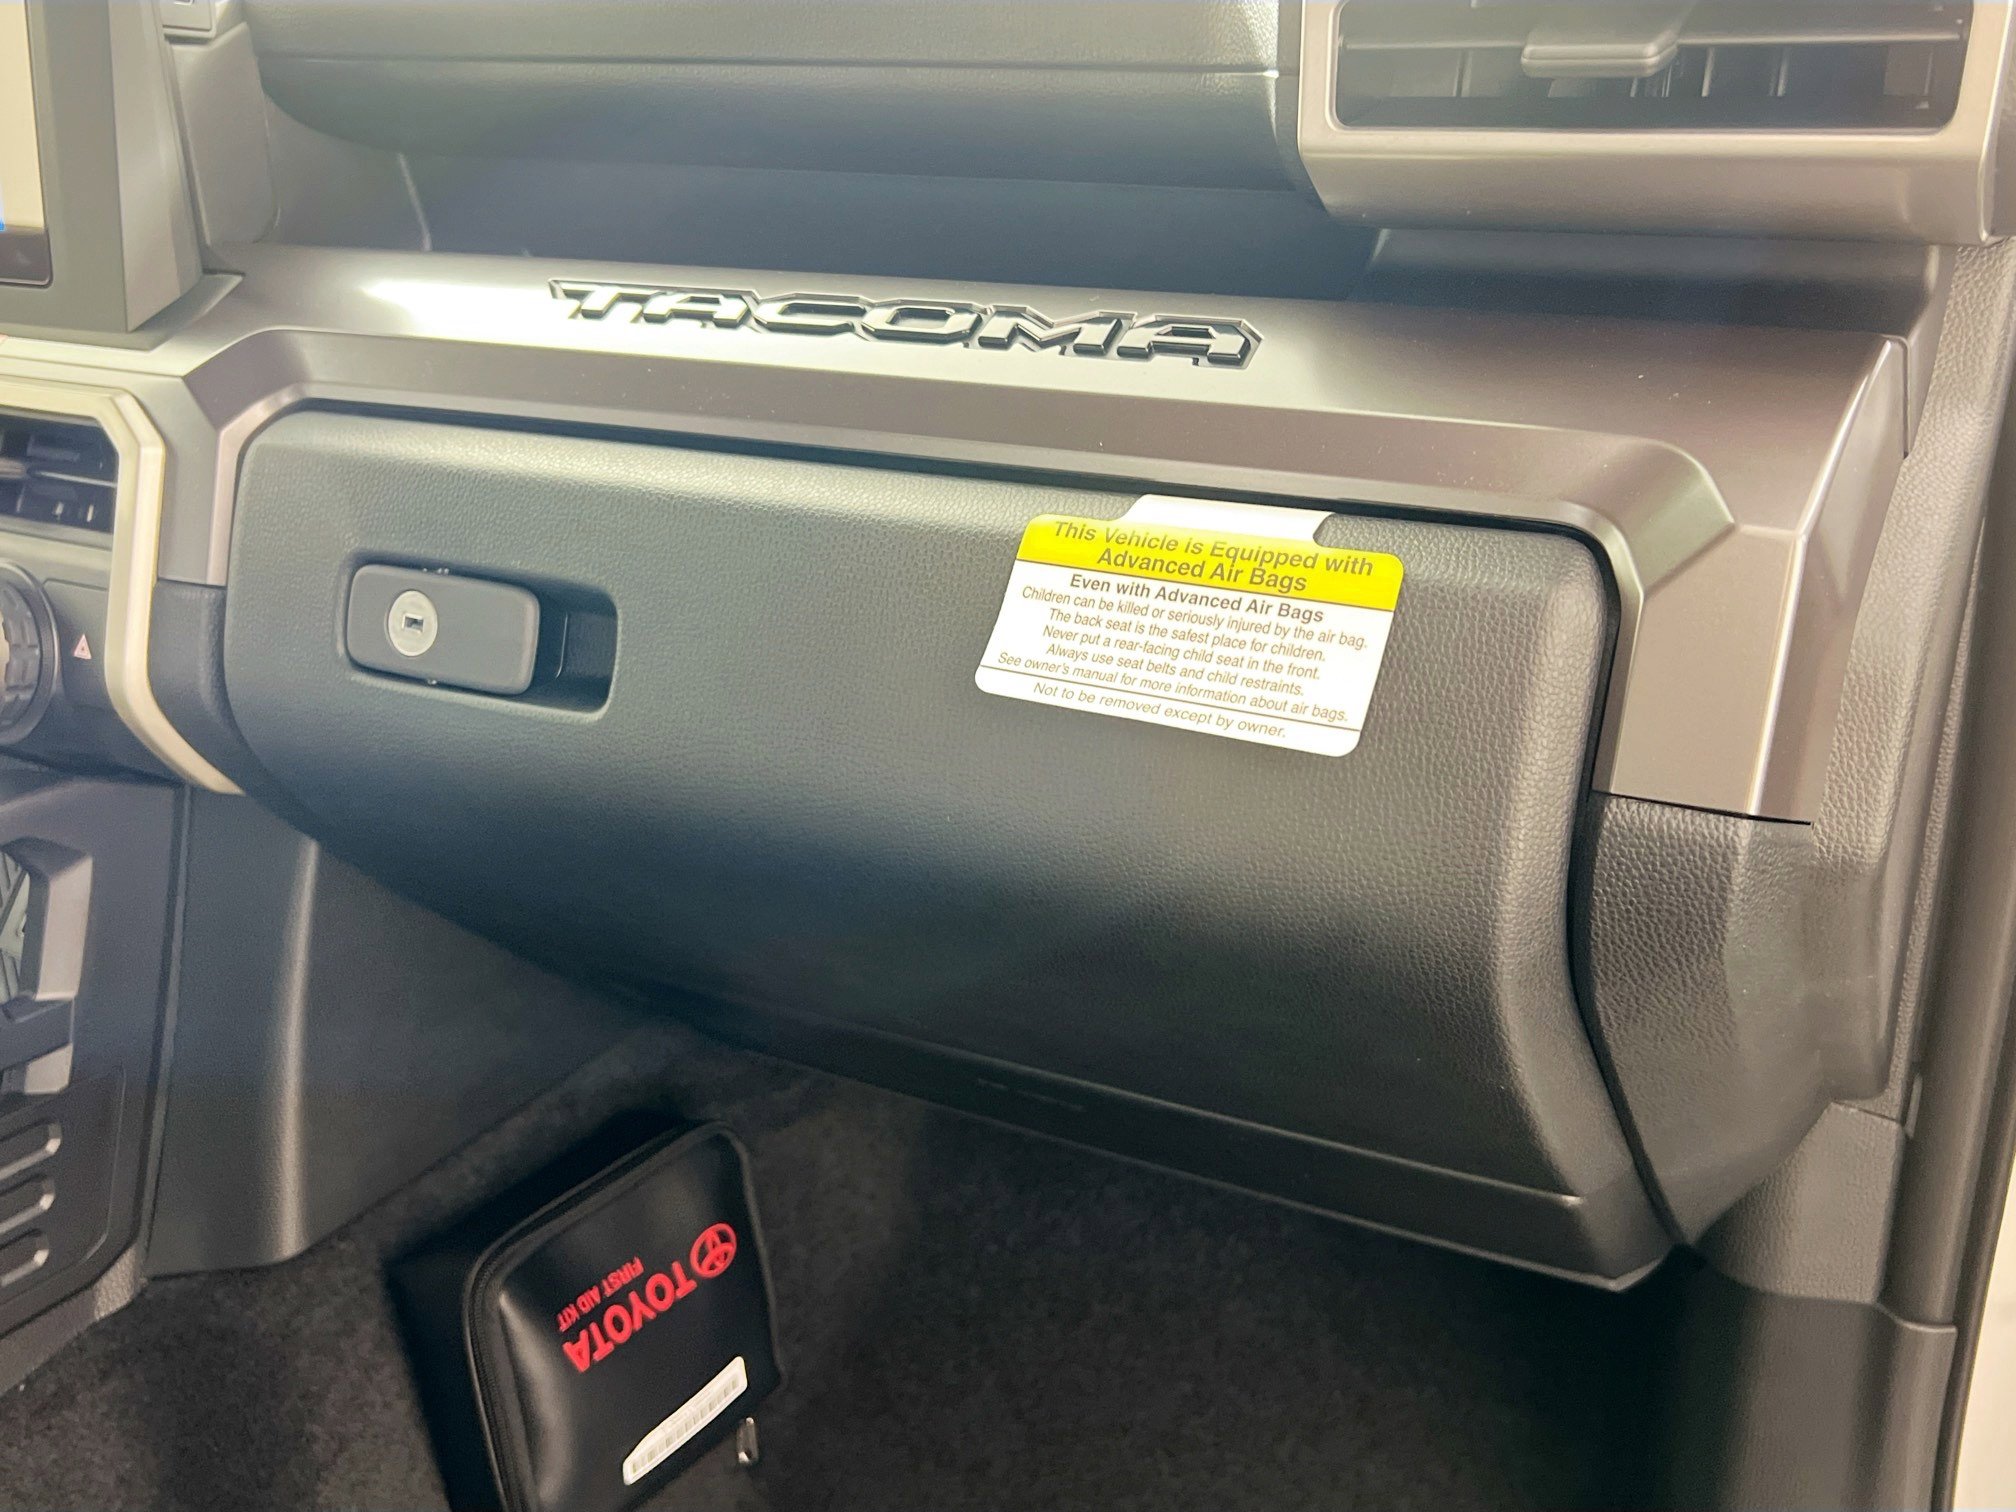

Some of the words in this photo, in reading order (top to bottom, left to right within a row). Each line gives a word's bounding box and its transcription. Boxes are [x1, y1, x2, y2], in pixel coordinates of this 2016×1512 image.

[550, 278, 1263, 369] TACOMA
[1054, 520, 1097, 542] This
[1104, 526, 1179, 552] Vehicle
[1183, 536, 1204, 555] is
[1208, 540, 1320, 570] Equipped
[1324, 556, 1374, 577] with
[1095, 546, 1207, 579] Advanced
[1207, 561, 1244, 583] Air
[1247, 566, 1308, 595] Bags
[1021, 584, 1071, 605] Children
[1072, 595, 1094, 609] can
[1096, 595, 1115, 612] be
[1115, 598, 1150, 617] killed
[1150, 606, 1166, 619] or
[1166, 608, 1225, 631] seriously
[1225, 614, 1272, 635] injured
[1272, 621, 1291, 640] by
[1292, 624, 1315, 641] the
[1316, 628, 1337, 644] air
[1337, 630, 1367, 651] bag.
[1069, 572, 1111, 593] Even
[1115, 580, 1151, 599] with
[1153, 584, 1243, 611] Advanced
[1244, 597, 1274, 615] Air
[1276, 601, 1324, 625] Bags
[1041, 623, 1079, 642] Never
[1078, 632, 1101, 646] put
[1101, 636, 1112, 648] a
[1112, 637, 1181, 660] rear-facing
[1181, 646, 1215, 664] child
[1214, 653, 1245, 669] seat
[1245, 658, 1260, 671] in
[1261, 658, 1284, 674] the
[1285, 661, 1320, 680] front.
[1048, 606, 1072, 623] The
[1072, 610, 1104, 628] back
[1103, 618, 1133, 633] seat
[1133, 619, 1146, 635] is
[1147, 622, 1169, 638] the
[1169, 627, 1210, 645] safest
[1209, 632, 1247, 650] place
[1248, 636, 1269, 653] for
[1269, 640, 1326, 662] children.
[996, 650, 1022, 667] See
[1022, 657, 1070, 675] owner's
[1070, 666, 1119, 683] manual
[1118, 671, 1139, 686] for
[1138, 677, 1173, 693] more
[1173, 680, 1247, 705] information
[1248, 693, 1288, 713] about
[1289, 700, 1310, 715] air
[1310, 702, 1348, 723] bags.
[1044, 642, 1089, 662] Always
[1090, 652, 1114, 666] use
[1115, 656, 1145, 671] seat
[1144, 658, 1177, 676] belts
[1178, 666, 1206, 680] and
[1205, 668, 1239, 686] child
[1238, 675, 1304, 697] restraints.
[1032, 680, 1059, 697] Not
[1060, 686, 1075, 700] to
[1076, 688, 1096, 704] be
[1097, 695, 1162, 715] removed
[1162, 706, 1213, 725] except
[1214, 713, 1235, 730] by
[1236, 719, 1286, 738] owner.
[576, 1285, 602, 1317] AID
[602, 1255, 645, 1298] FIRST
[556, 1303, 581, 1333] KIT
[562, 1261, 698, 1373] TOYOTA
